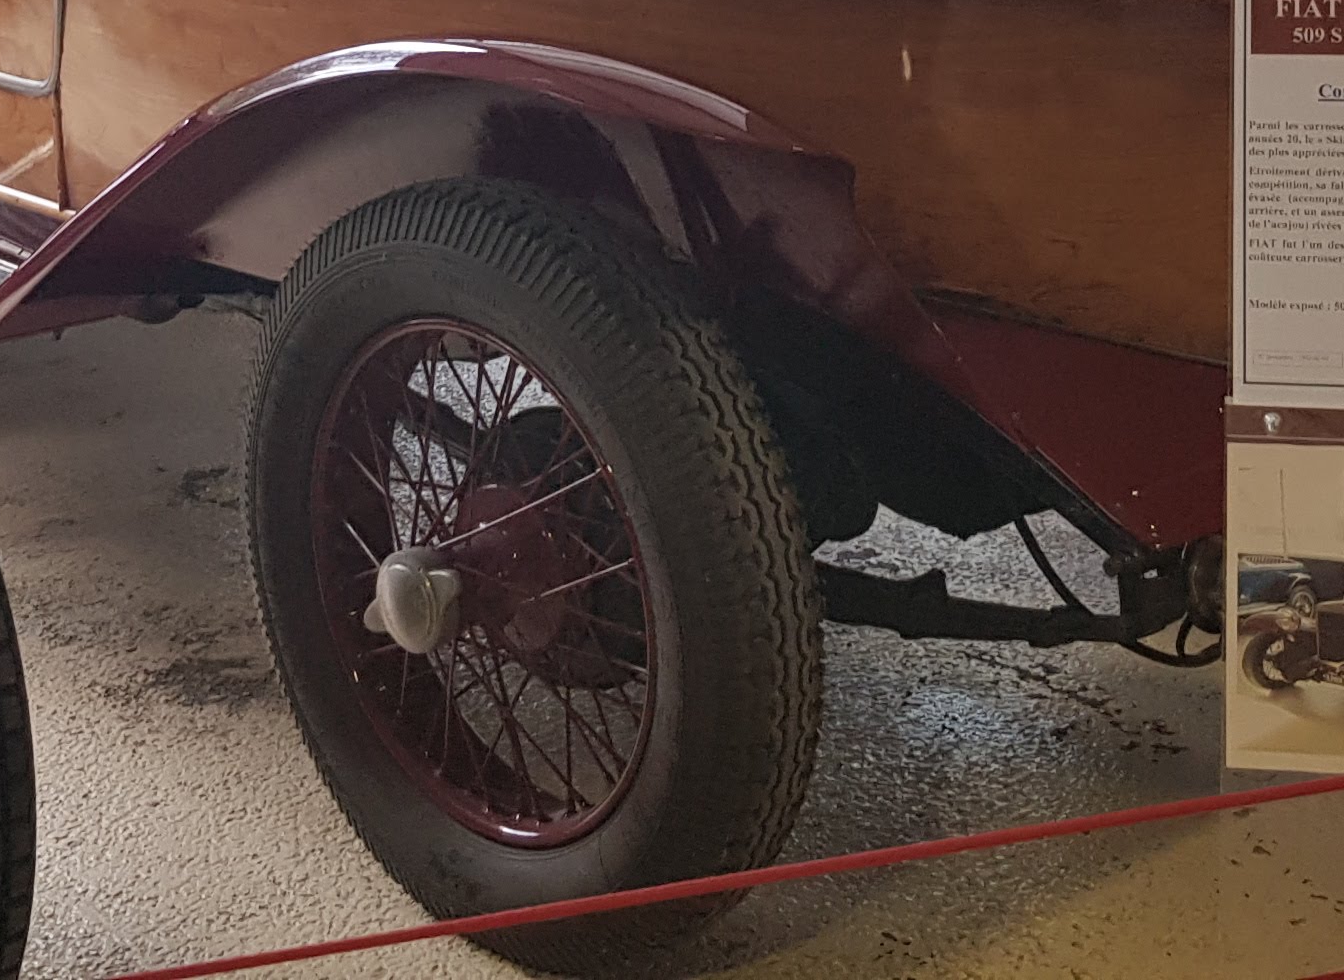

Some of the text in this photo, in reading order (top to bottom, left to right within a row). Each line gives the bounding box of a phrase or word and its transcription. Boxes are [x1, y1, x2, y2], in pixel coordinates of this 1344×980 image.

[1292, 27, 1325, 43] 509
[1330, 27, 1343, 43] S
[1249, 121, 1280, 130] Parmi
[1285, 121, 1299, 131] les
[1248, 147, 1265, 156] des
[1268, 147, 1289, 158] plus
[1248, 220, 1261, 229] de
[1249, 239, 1277, 248] FIAT
[1282, 240, 1297, 249] fut
[1327, 241, 1344, 250] des
[1248, 300, 1286, 309] Modèle
